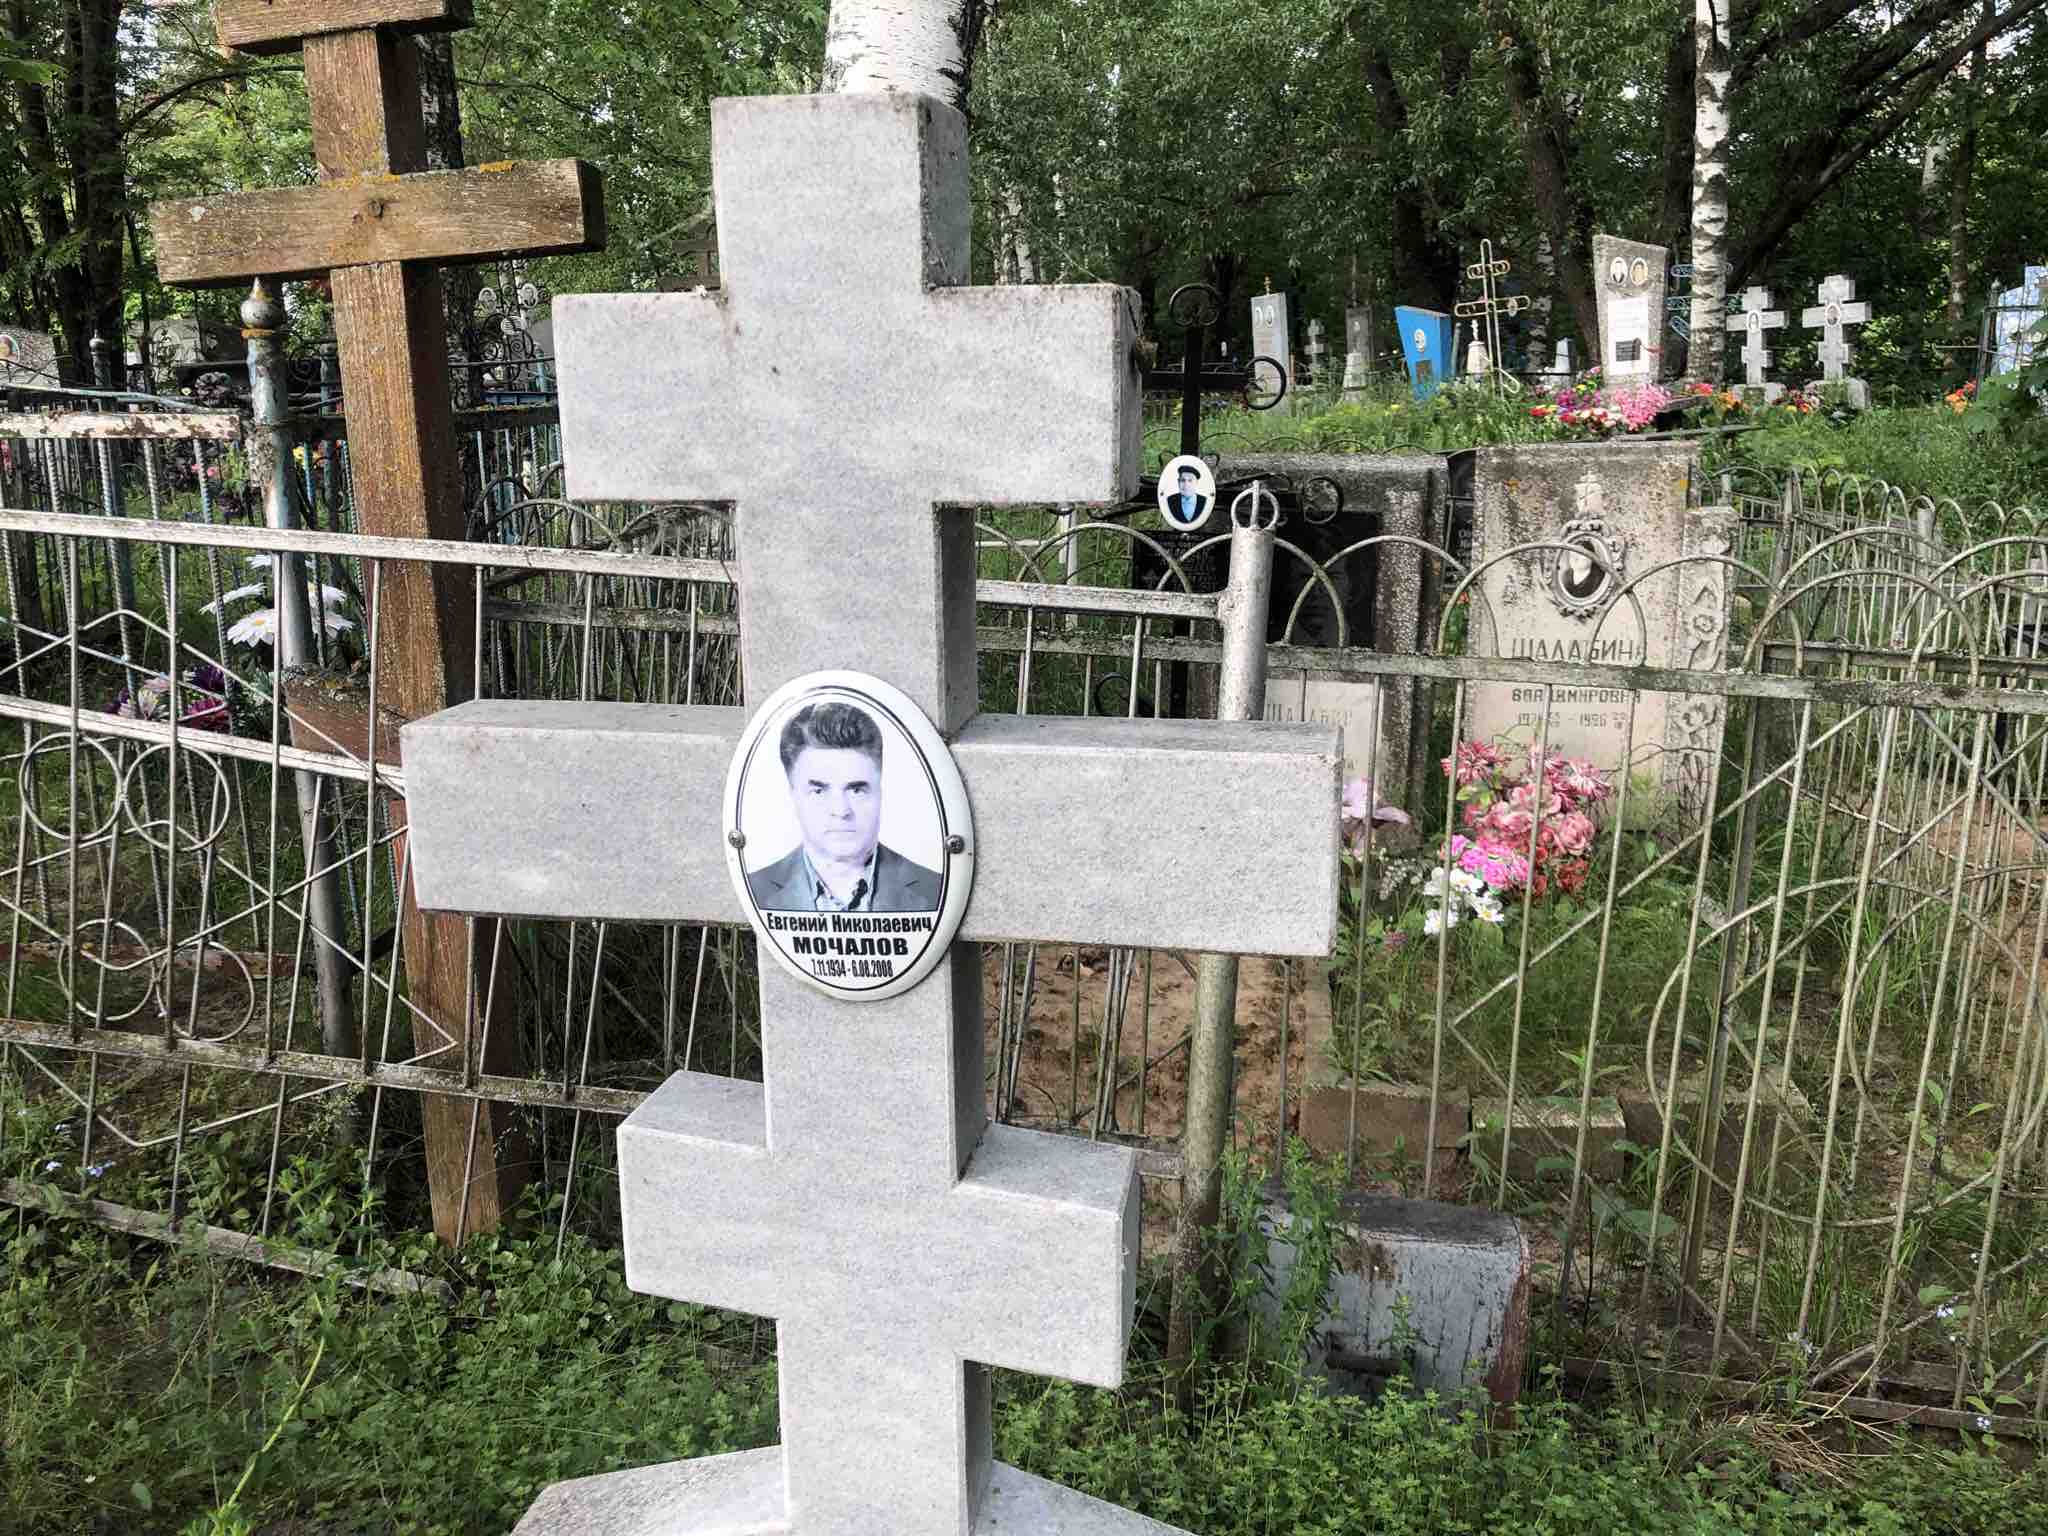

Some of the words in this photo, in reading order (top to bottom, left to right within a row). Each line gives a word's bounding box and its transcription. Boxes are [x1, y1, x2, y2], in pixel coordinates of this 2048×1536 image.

[767, 912, 828, 932] Евгений
[832, 914, 933, 933] Николаевич
[792, 936, 909, 955] МОЧАЛОВ
